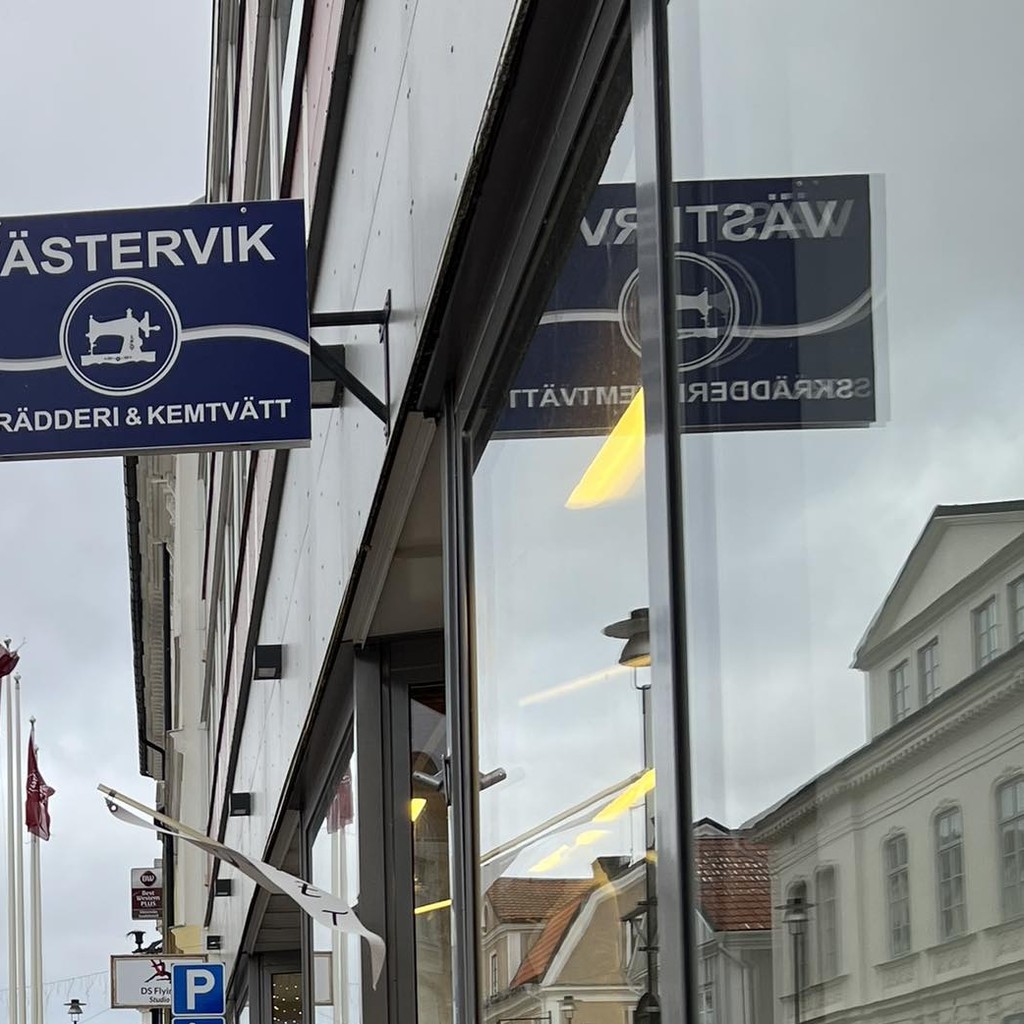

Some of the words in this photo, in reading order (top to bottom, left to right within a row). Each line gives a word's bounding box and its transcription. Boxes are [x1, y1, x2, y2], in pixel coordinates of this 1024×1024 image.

[125, 407, 142, 426] &
[147, 396, 292, 425] KEMTVÄTT
[141, 987, 152, 995] DS
[186, 969, 216, 1010] P
